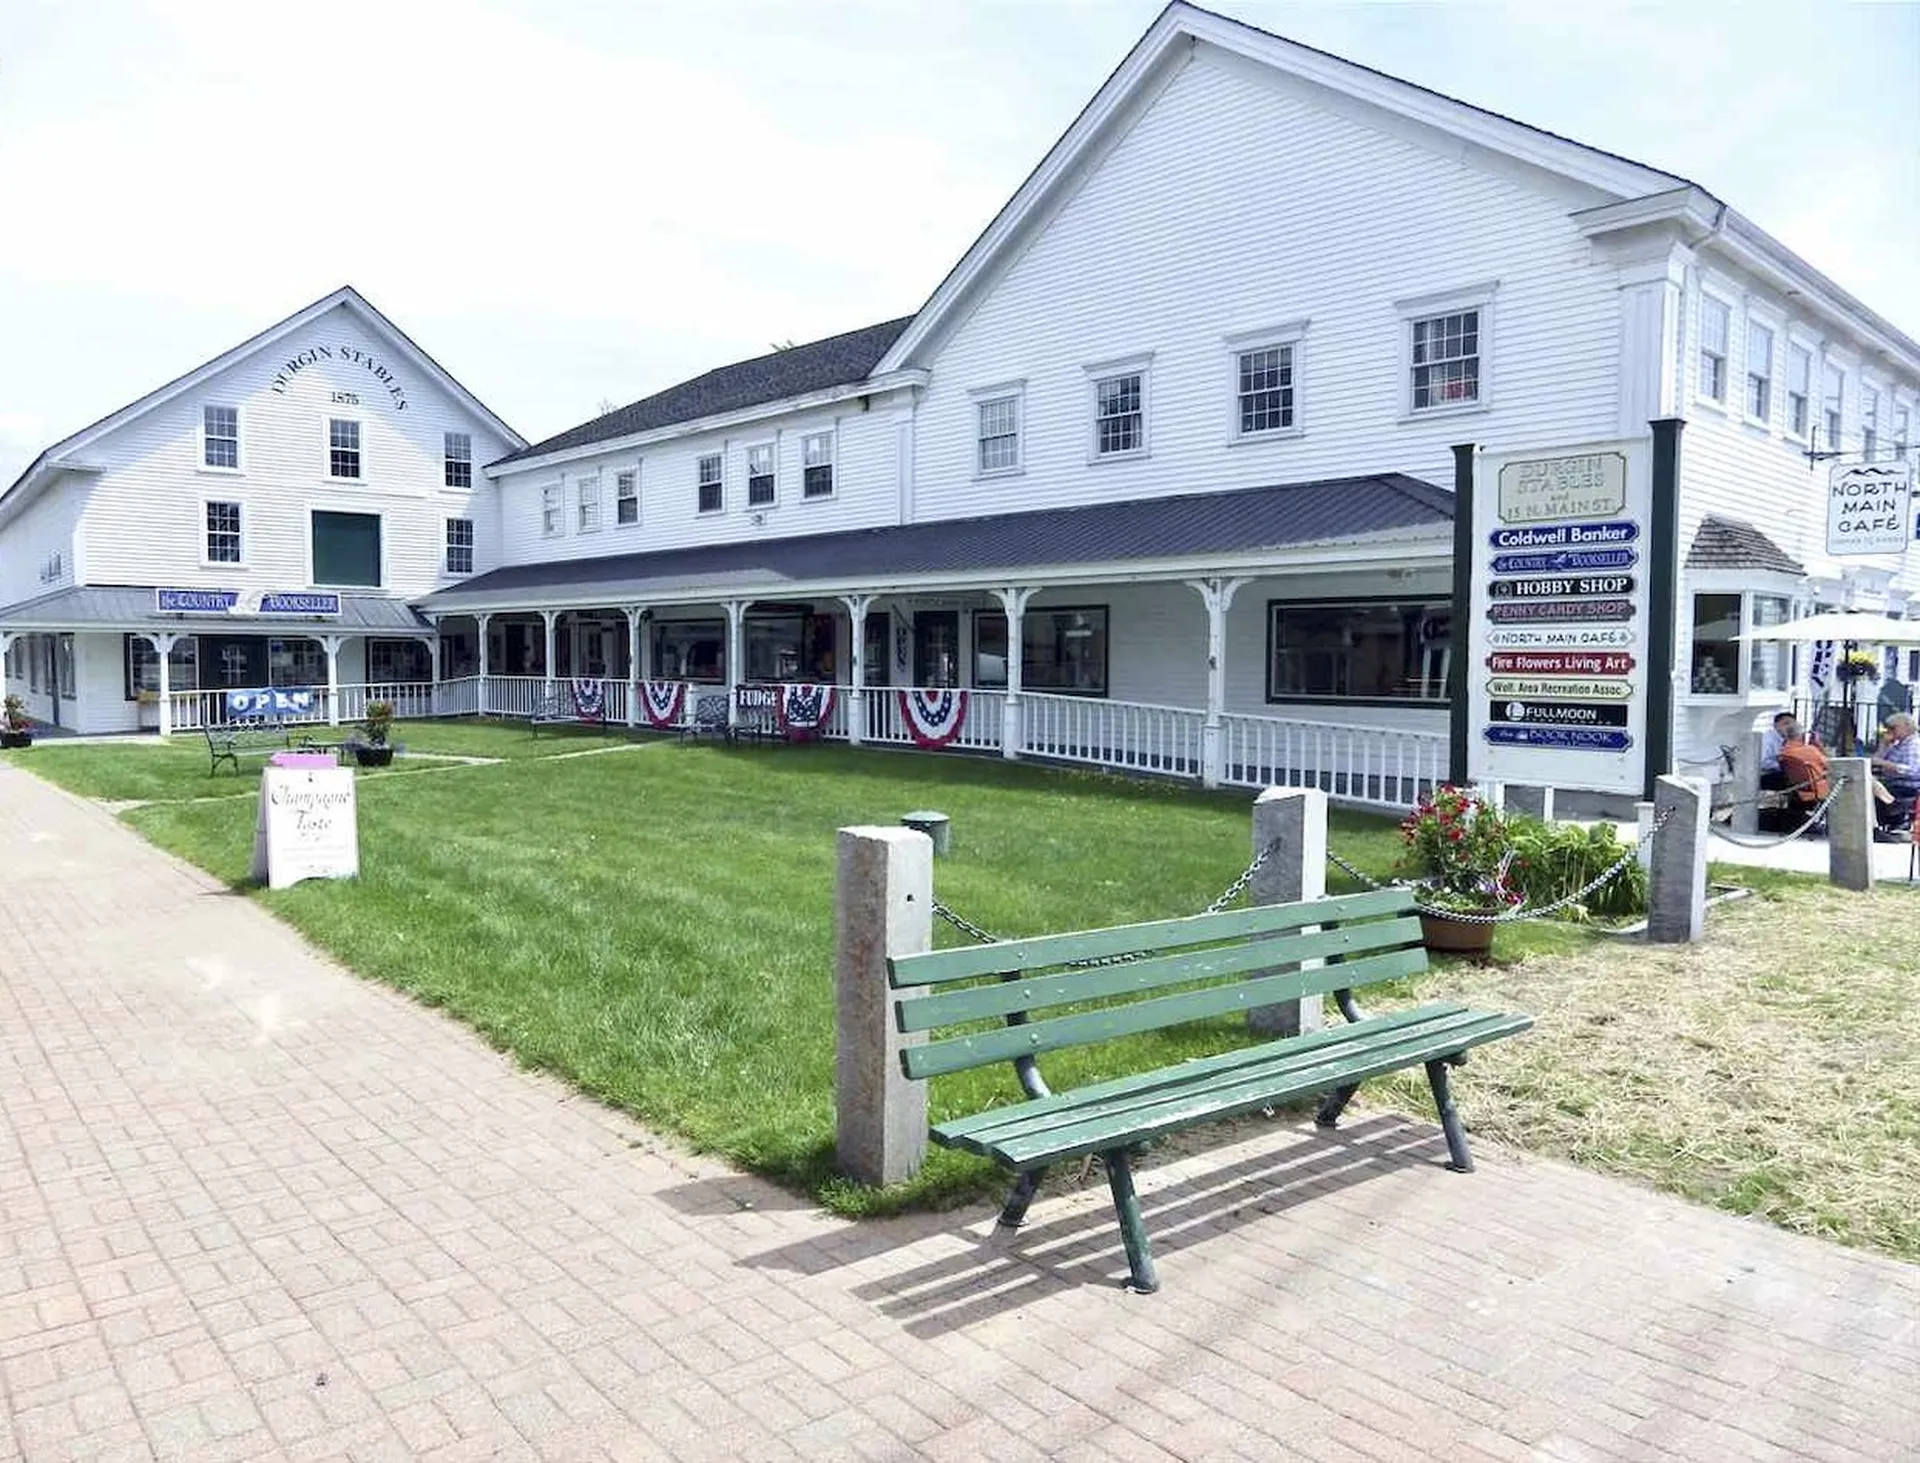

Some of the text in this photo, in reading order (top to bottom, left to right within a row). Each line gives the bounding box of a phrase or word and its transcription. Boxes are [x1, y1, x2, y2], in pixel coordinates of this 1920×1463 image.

[271, 346, 408, 411] DURGIN STABLES
[1832, 481, 1907, 497] NORTH
[1544, 500, 1590, 515] MAIN
[1841, 498, 1896, 514] MAIN
[1499, 525, 1628, 546] Coldwell Banker
[1516, 578, 1627, 595] HOBBY SHOP
[1493, 604, 1535, 618] PENNY
[1538, 602, 1583, 617] CANDY
[1587, 601, 1628, 615] SHOP
[1501, 632, 1541, 644] NORTH
[1545, 633, 1577, 645] MAIN
[1492, 655, 1628, 672] Fire Flowers Living Art
[1519, 683, 1538, 693] Area
[1541, 682, 1591, 695] Recreation
[232, 692, 310, 711] OPEN
[1526, 706, 1598, 720] FULLMOON
